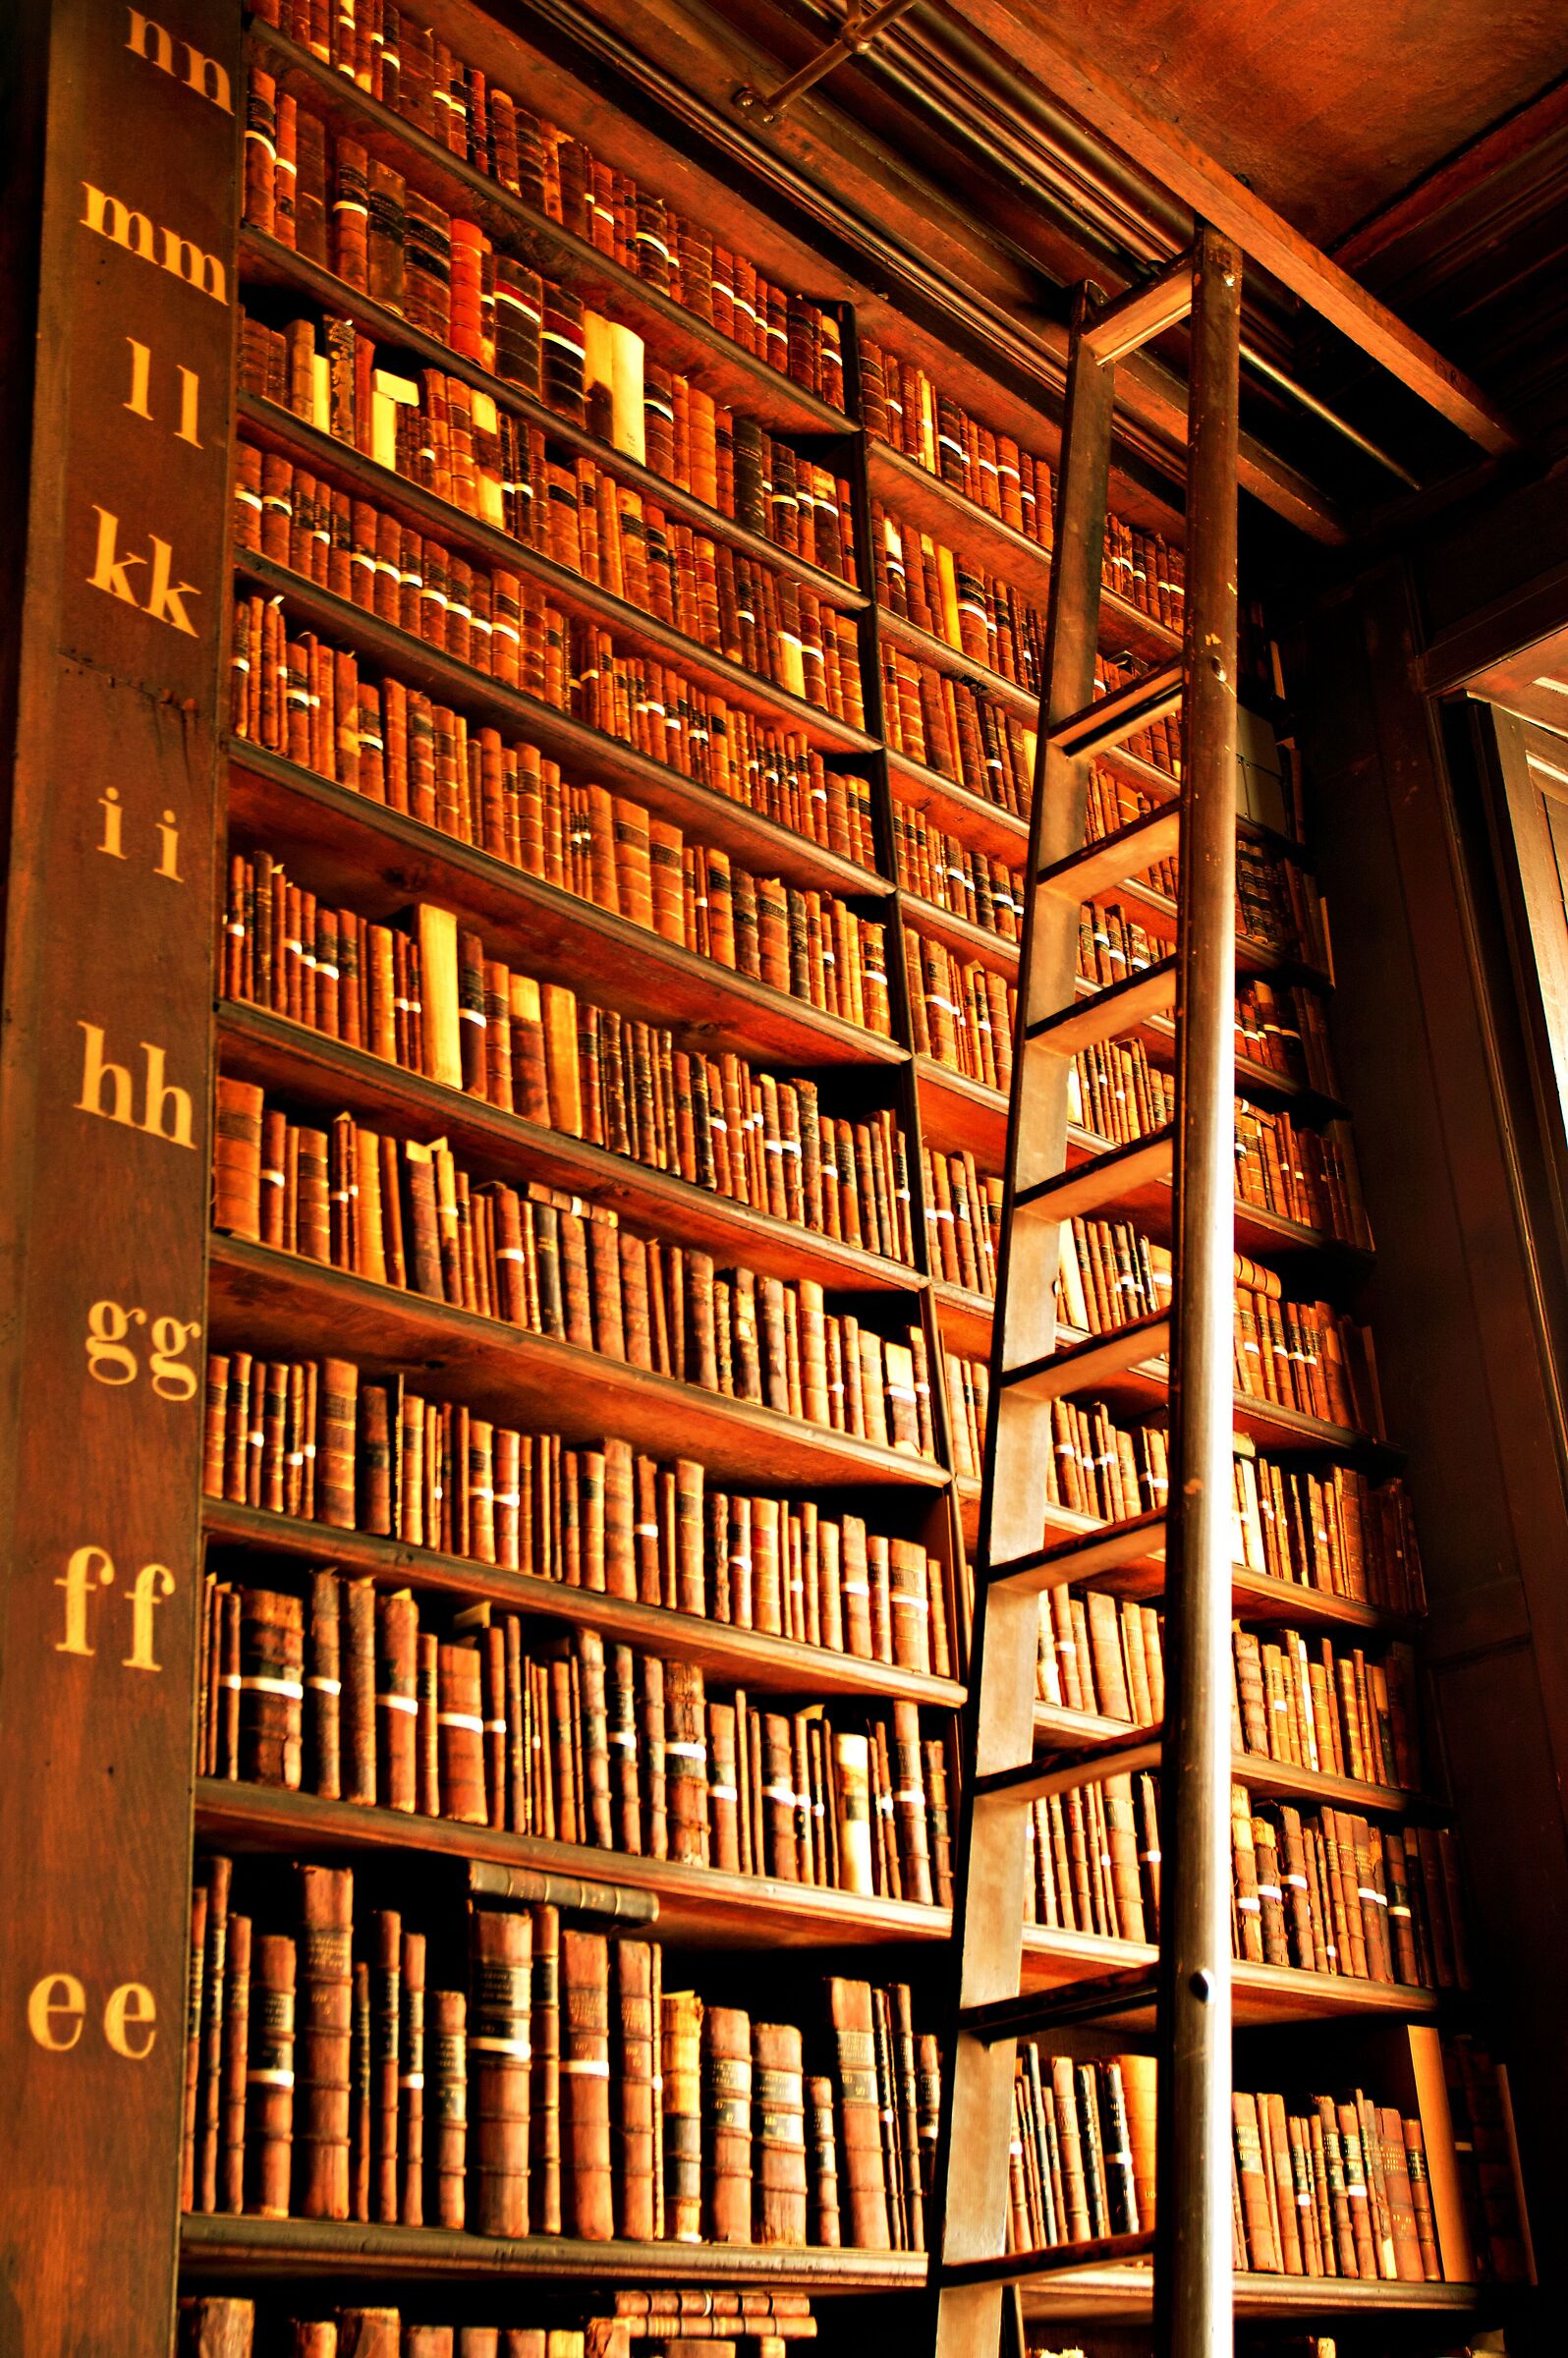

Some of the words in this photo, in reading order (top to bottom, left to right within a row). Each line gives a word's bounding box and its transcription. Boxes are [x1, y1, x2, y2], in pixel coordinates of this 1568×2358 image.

[125, 7, 235, 116] nn
[80, 182, 229, 306] mm
[86, 504, 201, 639] kk
[98, 787, 185, 883] ii
[75, 1020, 197, 1150] hh
[85, 1300, 202, 1402] gg
[54, 1545, 176, 1672] ff
[28, 1973, 157, 2059] ee
